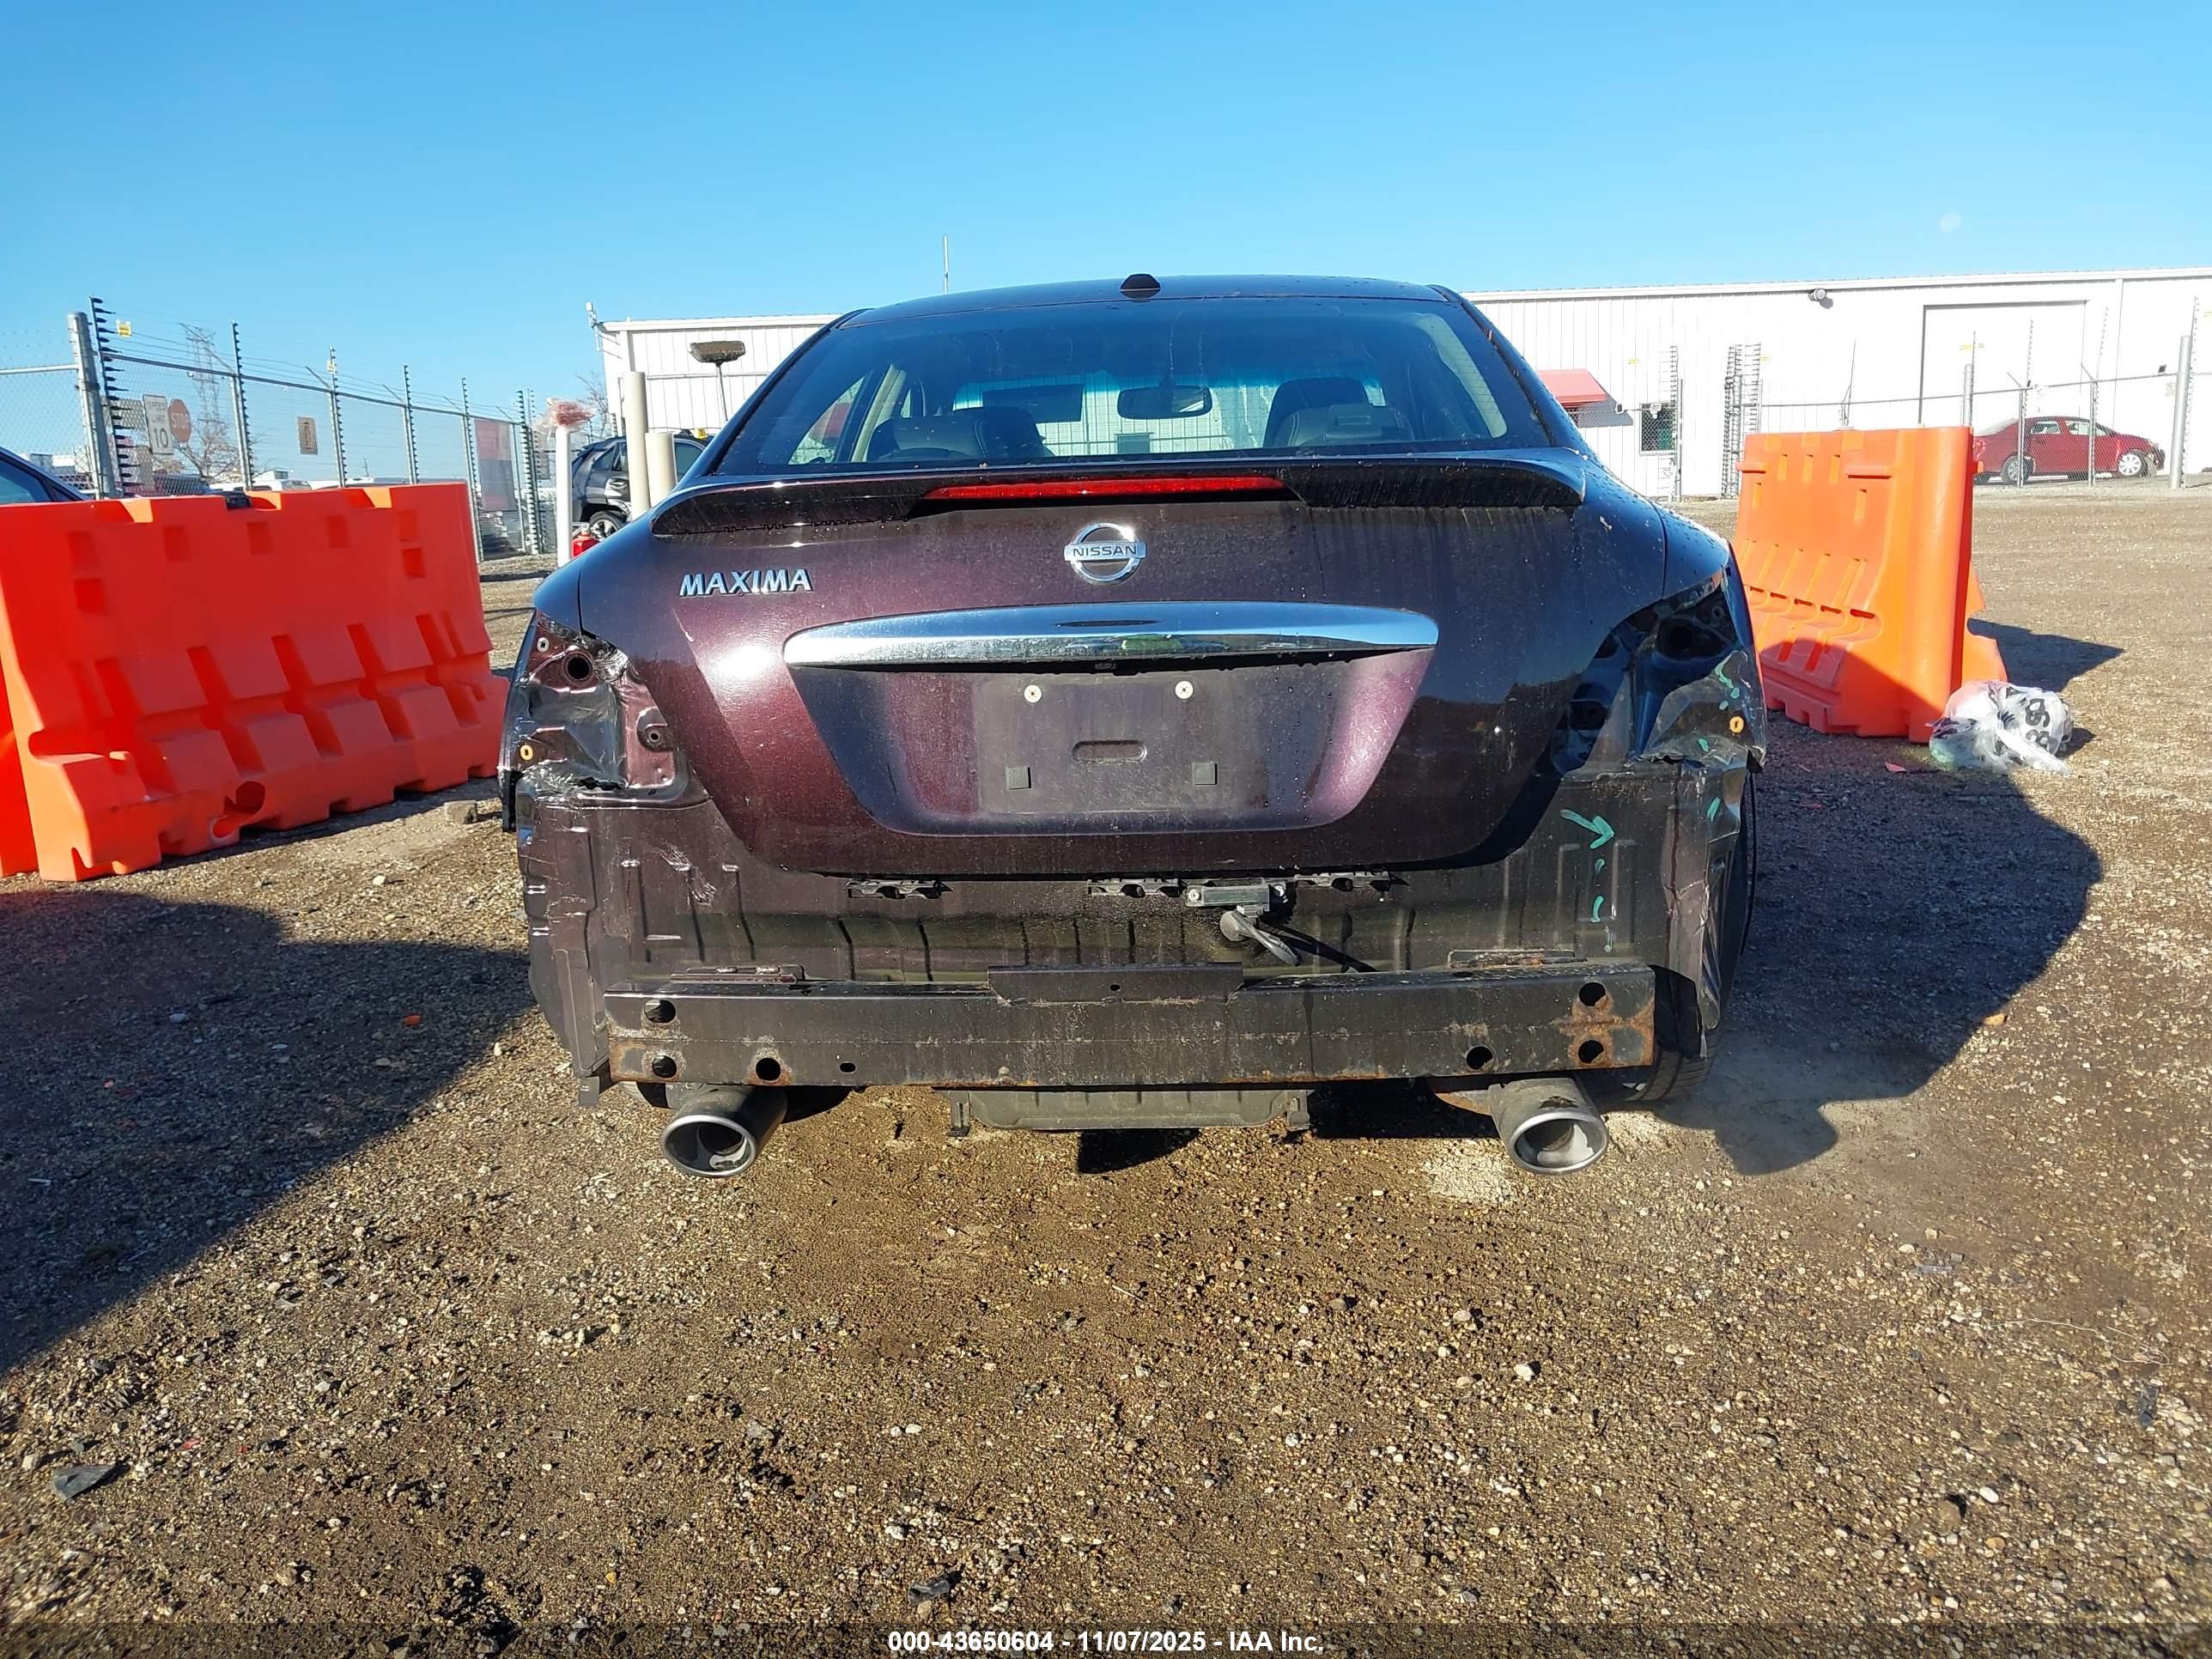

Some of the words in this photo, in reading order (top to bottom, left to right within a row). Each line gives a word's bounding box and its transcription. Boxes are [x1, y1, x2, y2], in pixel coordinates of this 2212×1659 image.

[154, 428, 169, 448] 10
[1073, 545, 1137, 557] NISSAN
[679, 568, 814, 597] MAXIMA
